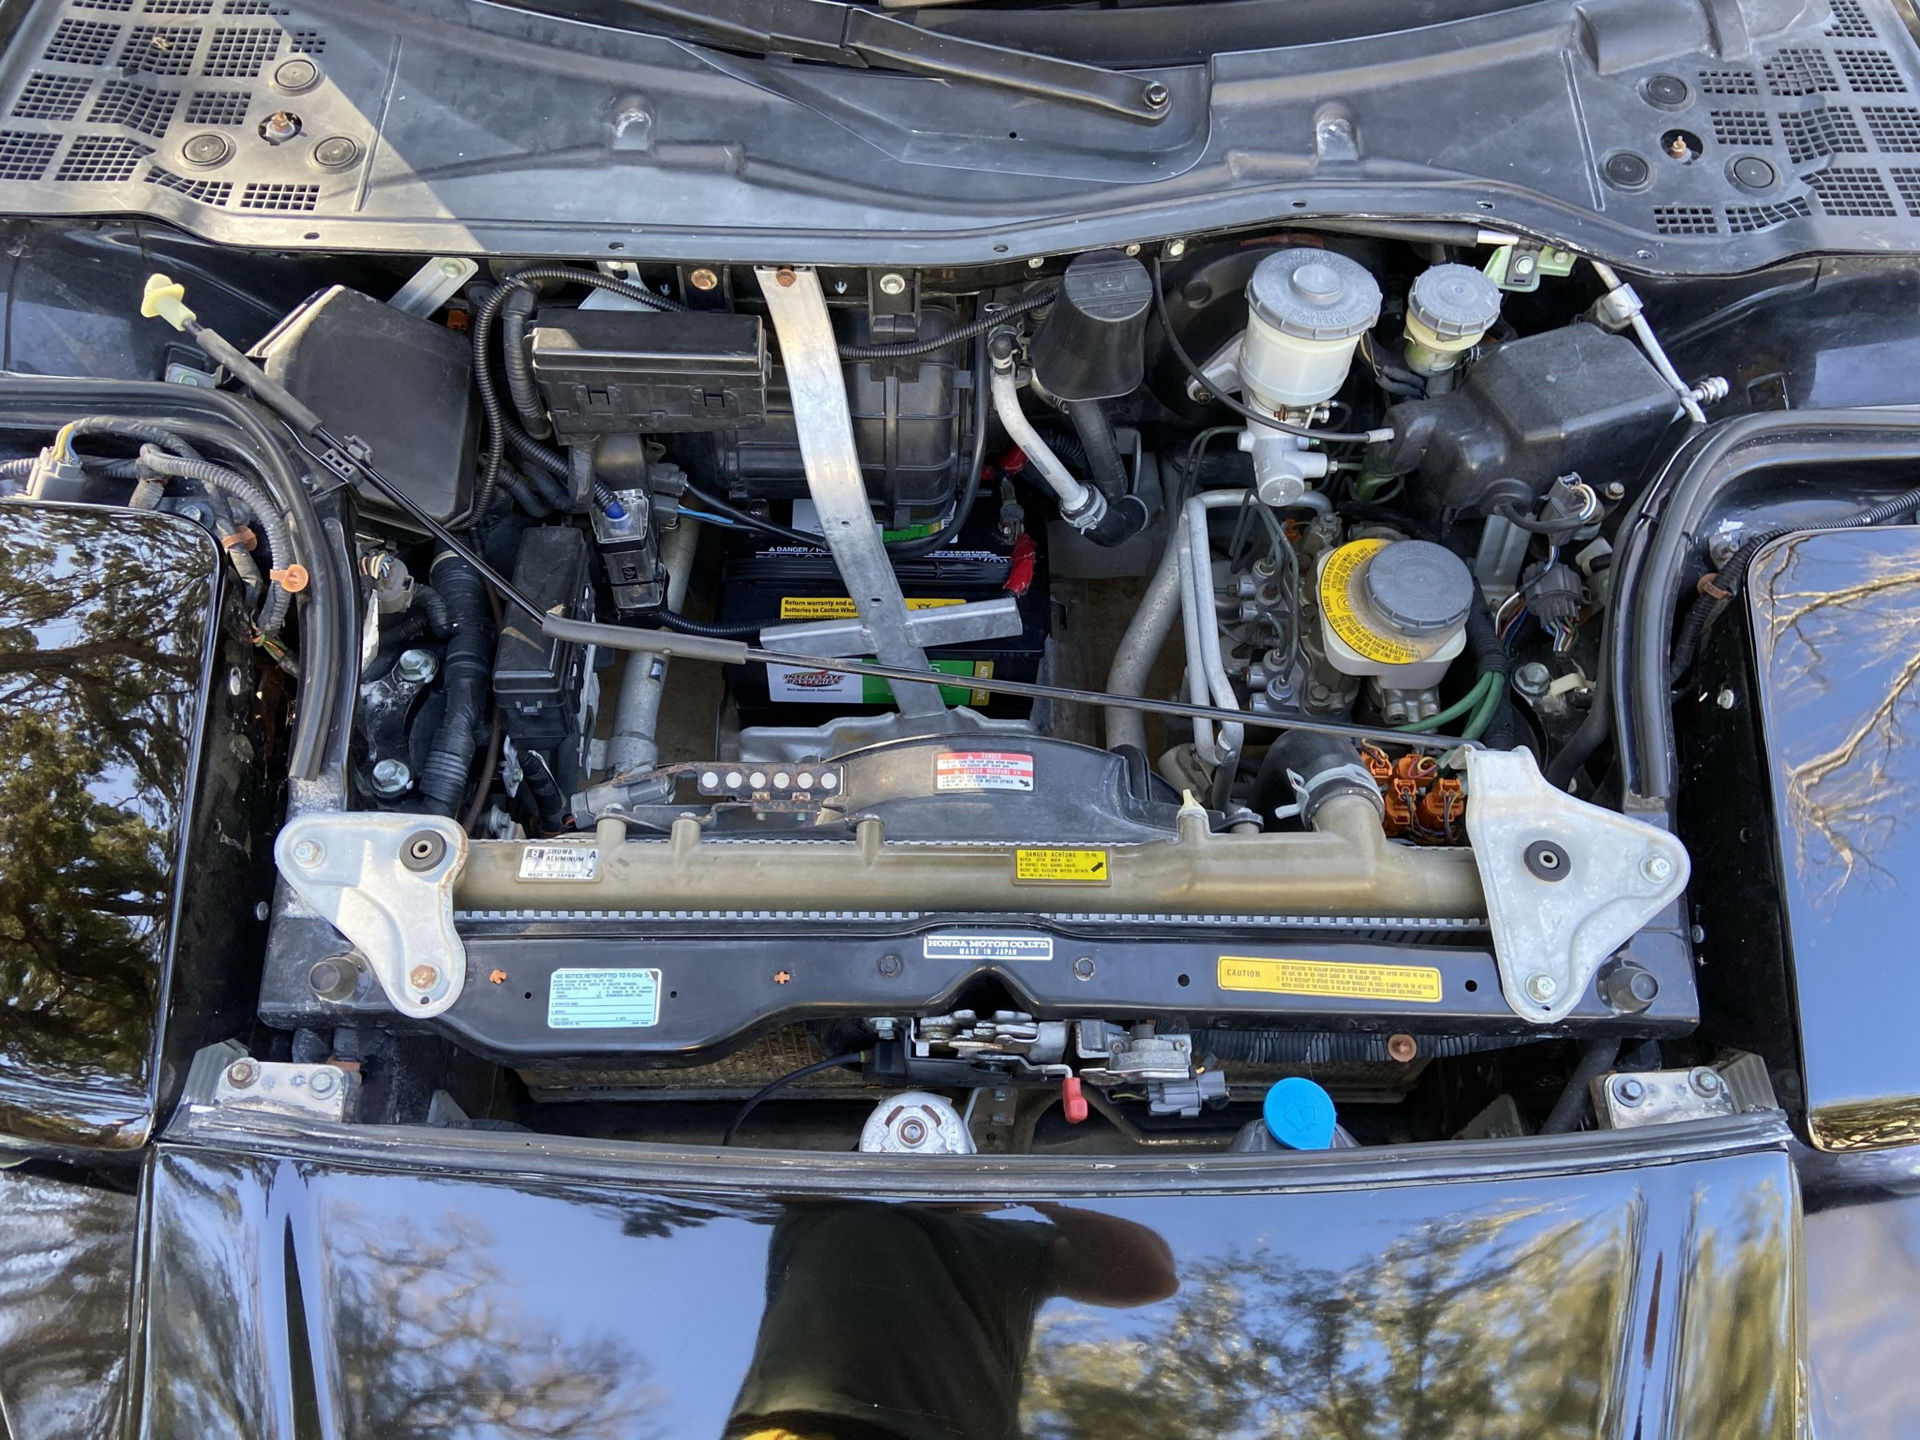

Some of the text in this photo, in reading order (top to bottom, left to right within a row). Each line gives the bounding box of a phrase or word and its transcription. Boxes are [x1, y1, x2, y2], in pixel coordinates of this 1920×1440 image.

[1344, 615, 1362, 634] PRESSURE
[1362, 633, 1373, 642] HIGH
[1372, 640, 1389, 651] UNDER
[1389, 648, 1404, 656] FLUID
[590, 851, 596, 859] A
[586, 869, 593, 877] Z
[969, 940, 1010, 948] MOTOR
[1226, 968, 1261, 978] CAUTION
